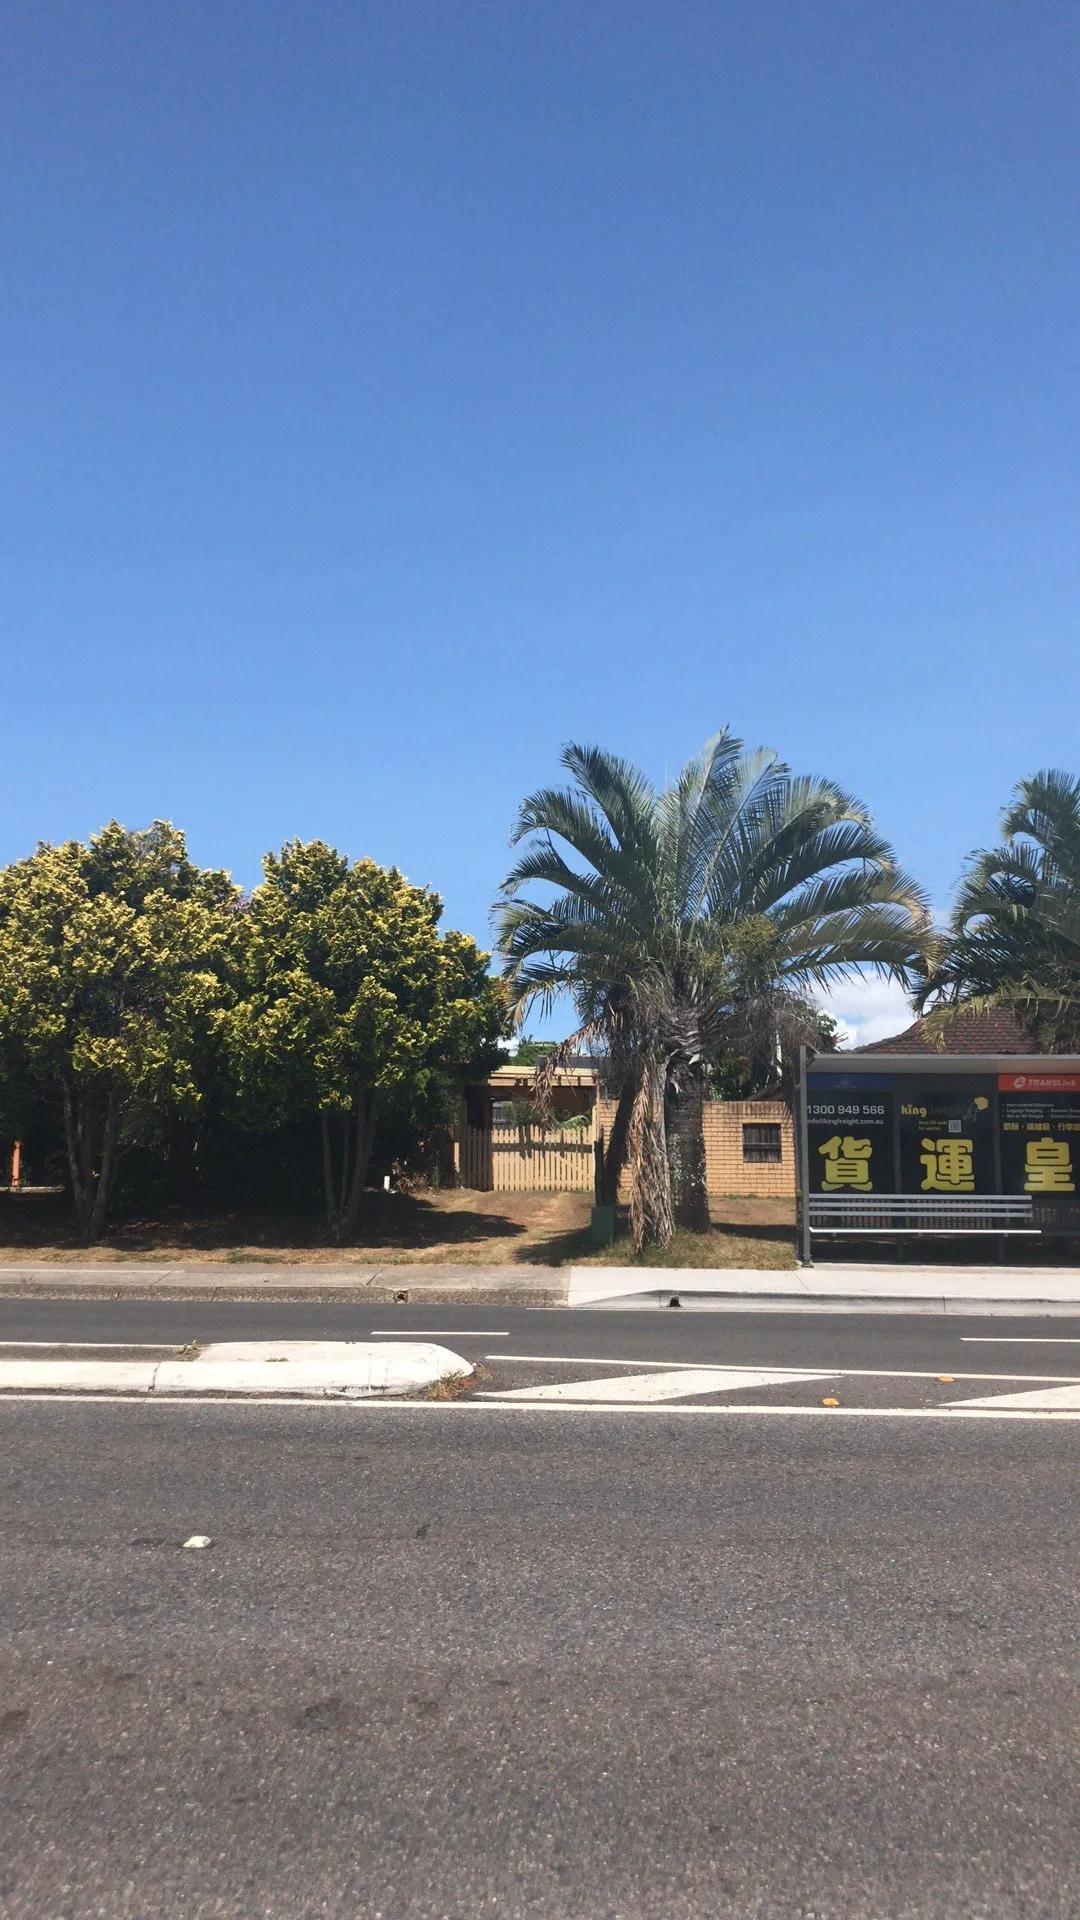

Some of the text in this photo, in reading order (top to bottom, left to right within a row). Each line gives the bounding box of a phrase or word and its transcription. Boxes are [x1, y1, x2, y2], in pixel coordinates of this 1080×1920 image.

[807, 1105, 885, 1115] 1300 949 566
[901, 1104, 927, 1118] king
[818, 1135, 1075, 1192] 貨 運 皇
